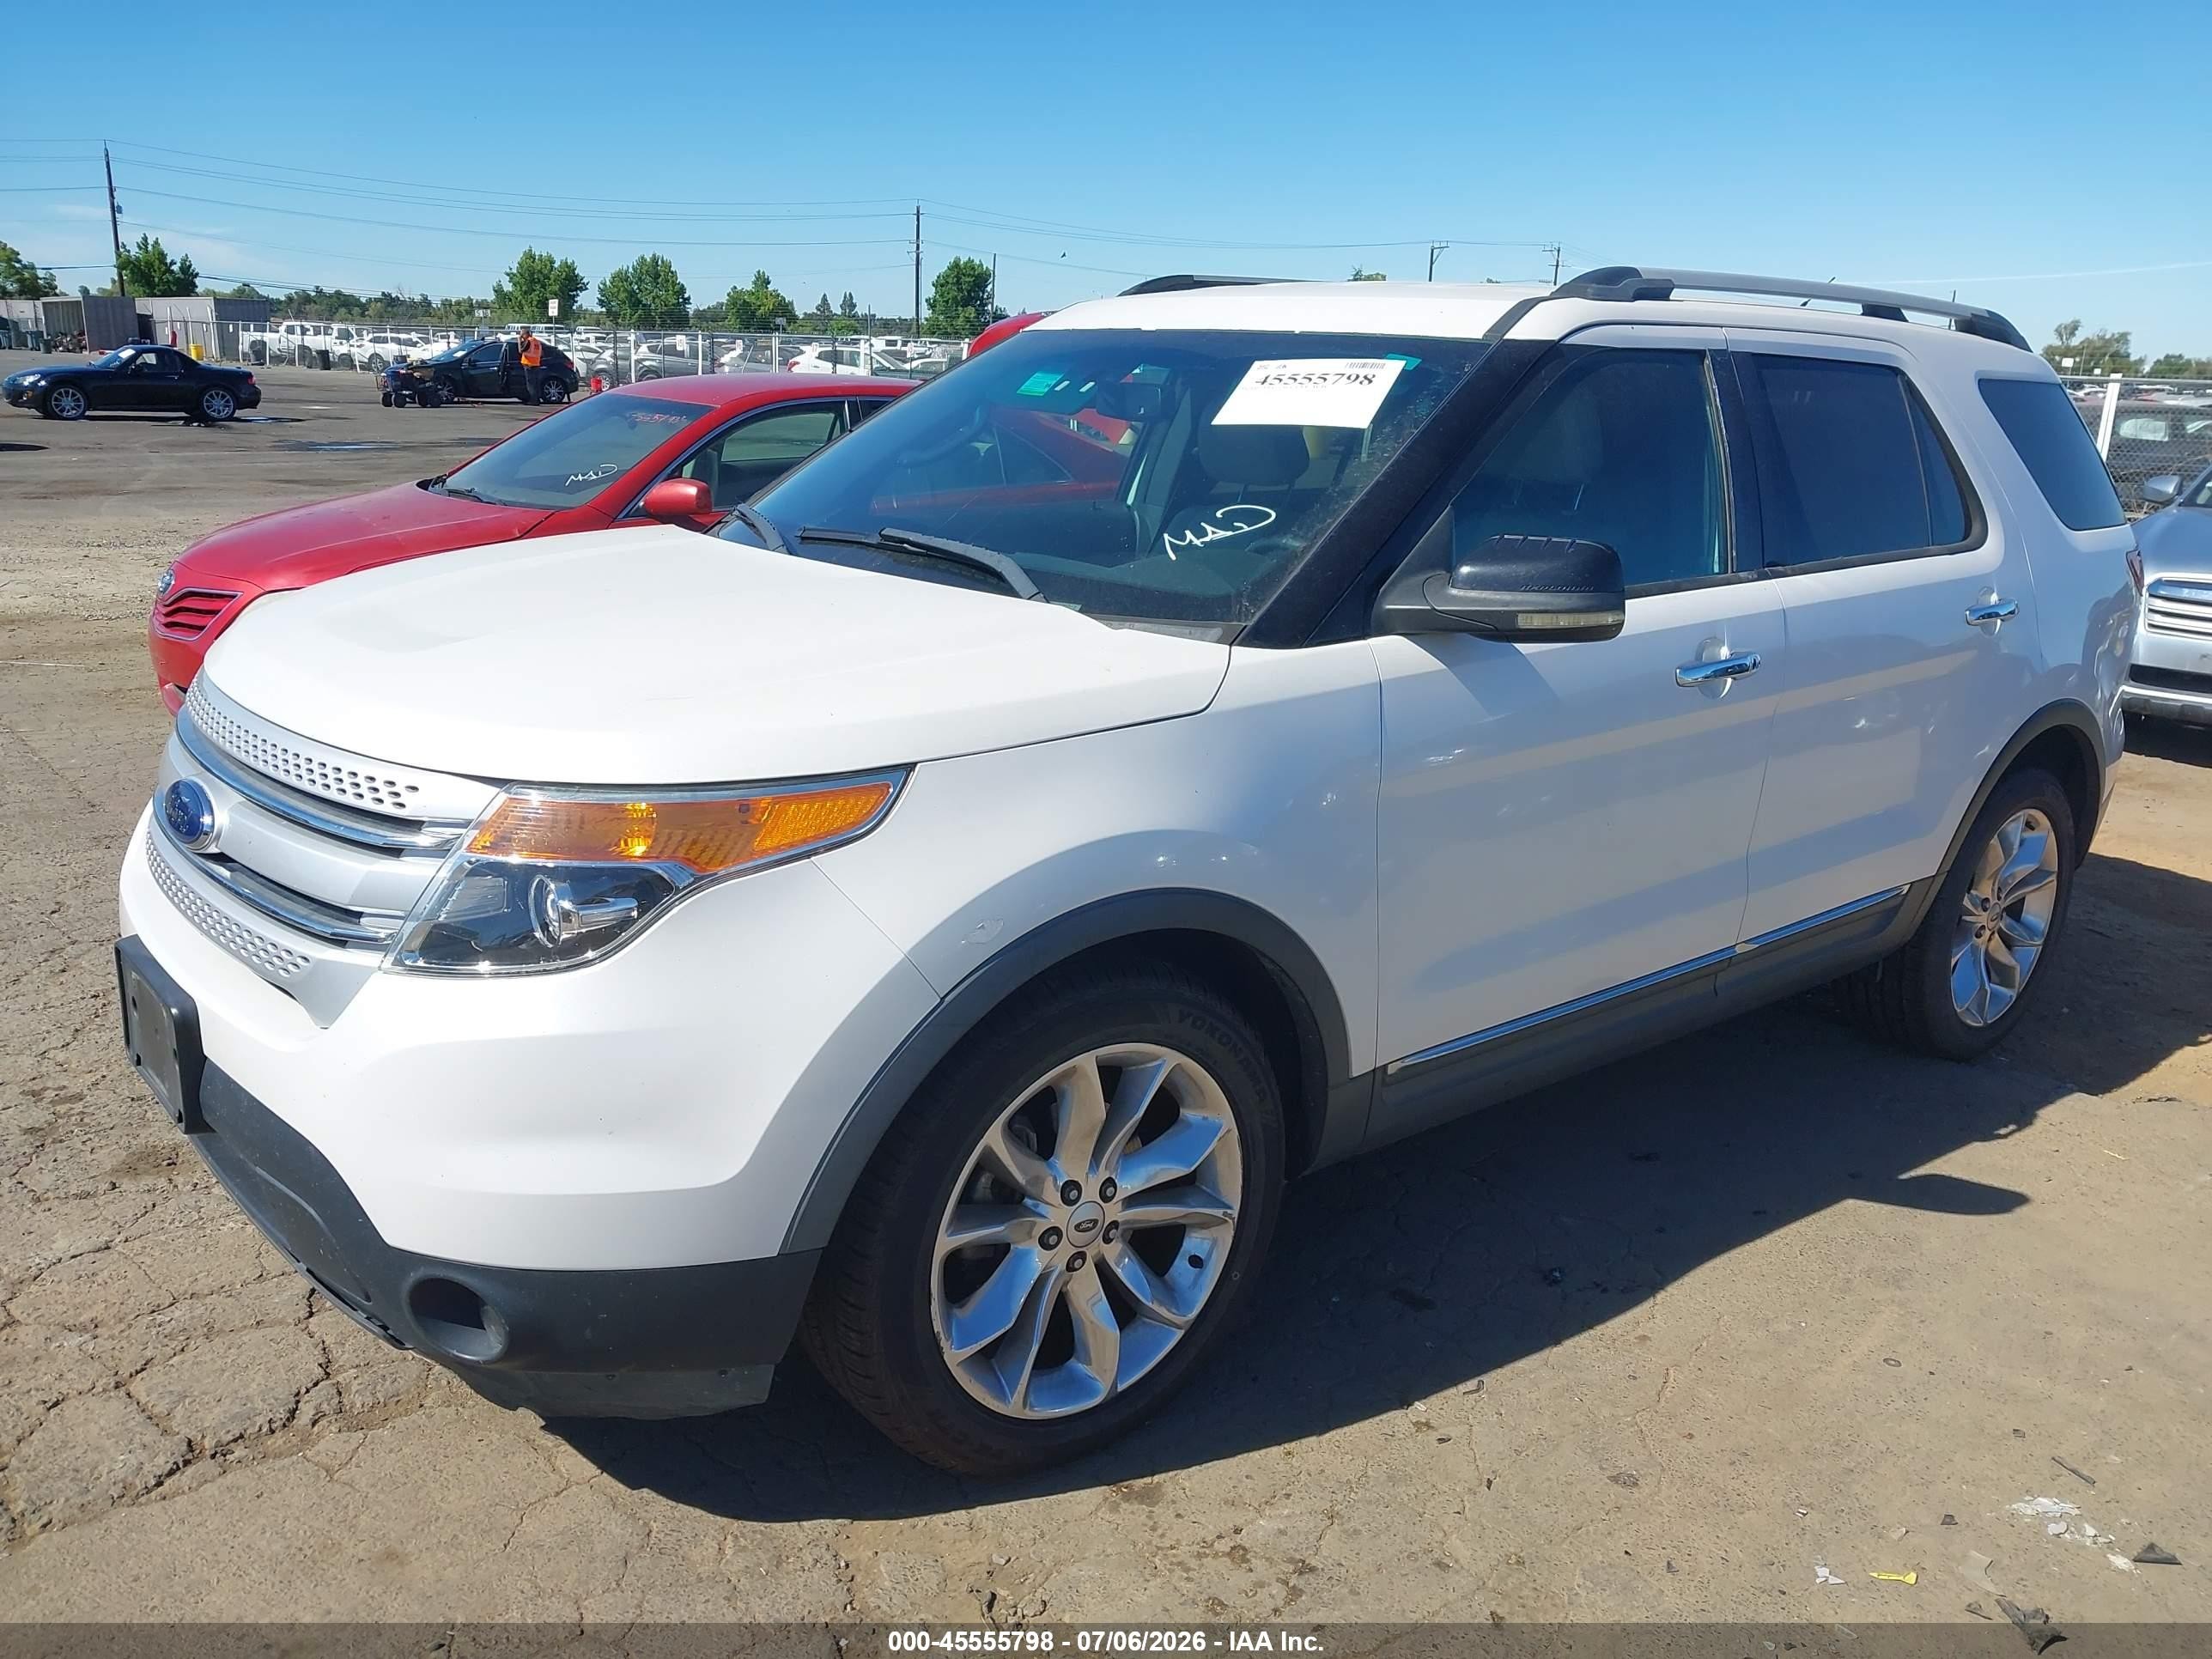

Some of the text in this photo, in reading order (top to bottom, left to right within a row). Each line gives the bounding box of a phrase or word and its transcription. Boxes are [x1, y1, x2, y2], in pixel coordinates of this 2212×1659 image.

[1254, 372, 1376, 386] 45555798
[1162, 503, 1278, 562] MAD
[1177, 1007, 1268, 1104] YOKOHAMA
